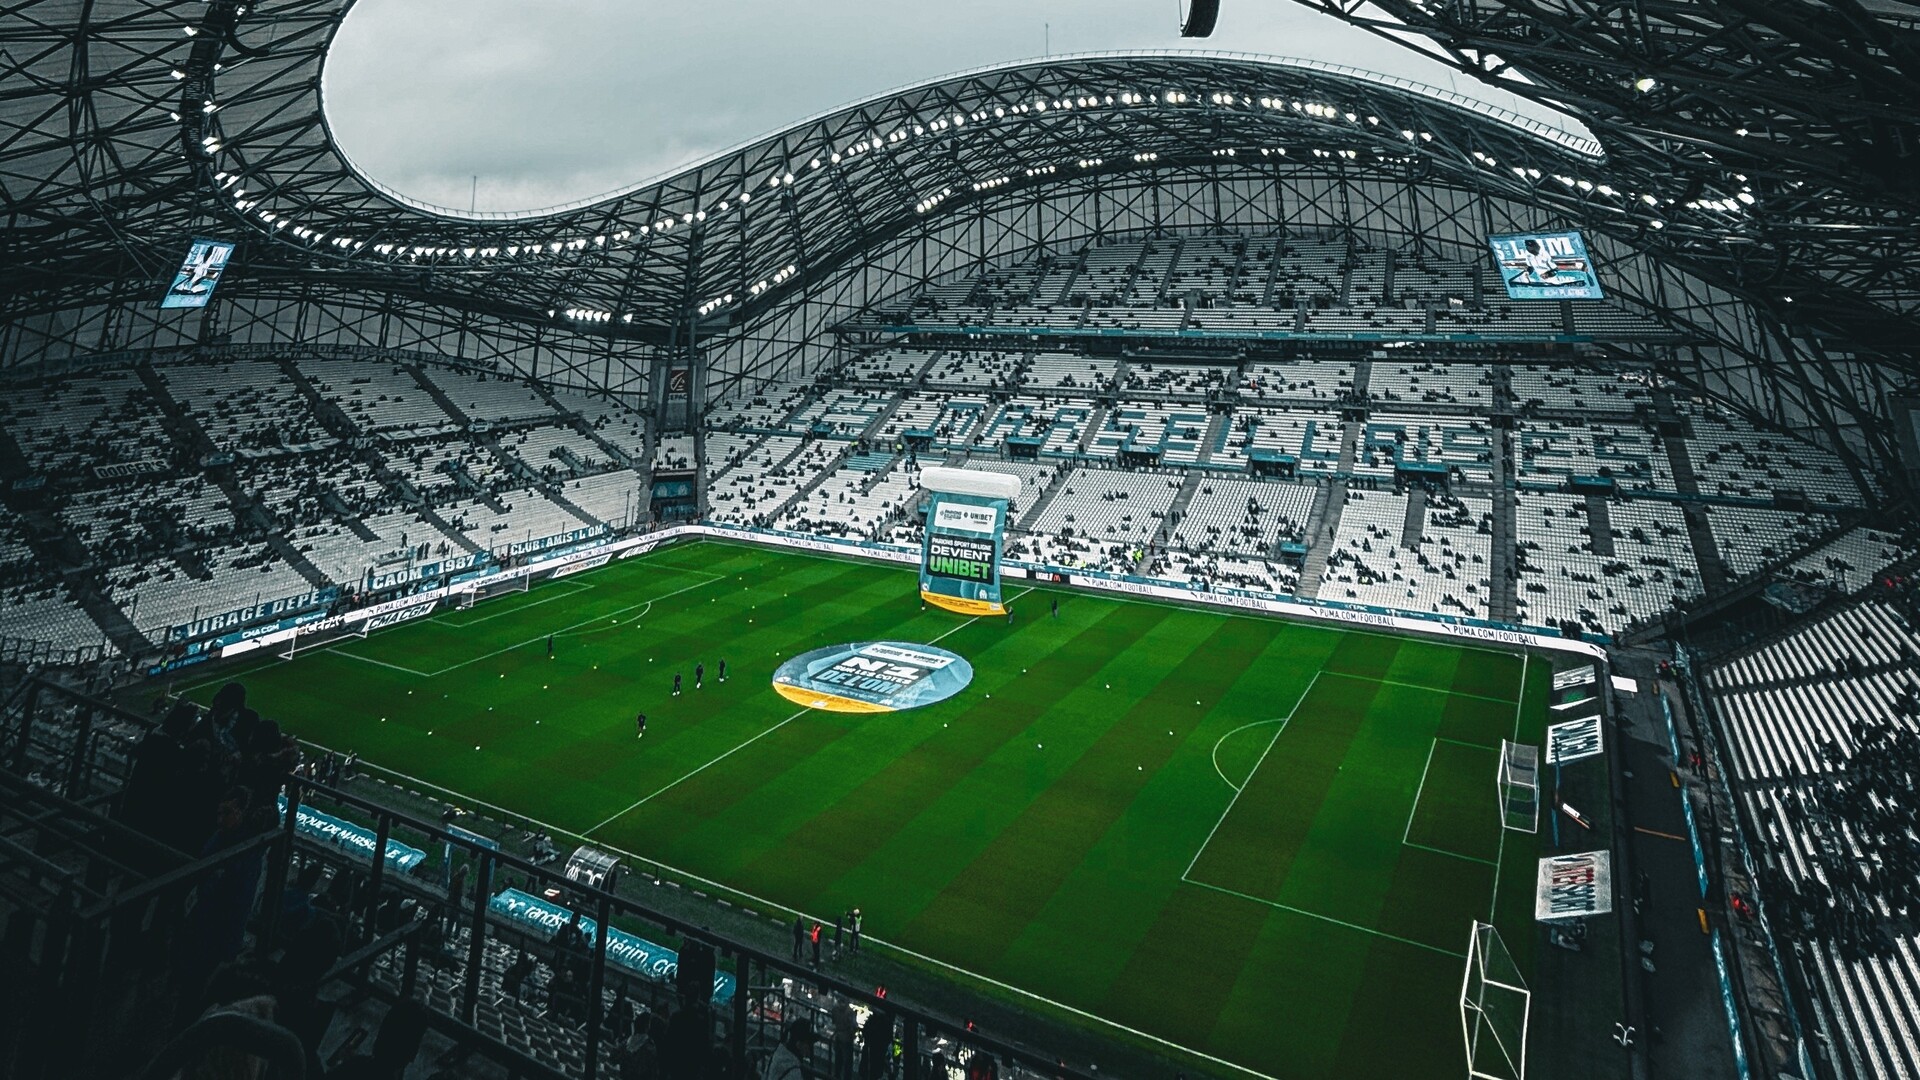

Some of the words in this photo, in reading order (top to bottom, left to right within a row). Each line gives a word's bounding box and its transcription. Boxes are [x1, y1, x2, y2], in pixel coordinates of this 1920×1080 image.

[96, 460, 167, 478] DODGER'S
[970, 512, 993, 521] UNIBET
[510, 539, 539, 556] CLUB
[546, 532, 573, 547] AMIS
[930, 544, 991, 562] DEVIENT
[954, 540, 970, 548] SPORT
[372, 567, 423, 590] CAOM
[438, 554, 476, 574] 1987
[929, 555, 990, 579] UNIBET
[186, 607, 265, 637] VIRAGE
[369, 613, 397, 630] CMA
[399, 604, 432, 621] CGM
[816, 670, 847, 684] DE
[833, 664, 855, 674] SUR
[322, 823, 342, 836] DE
